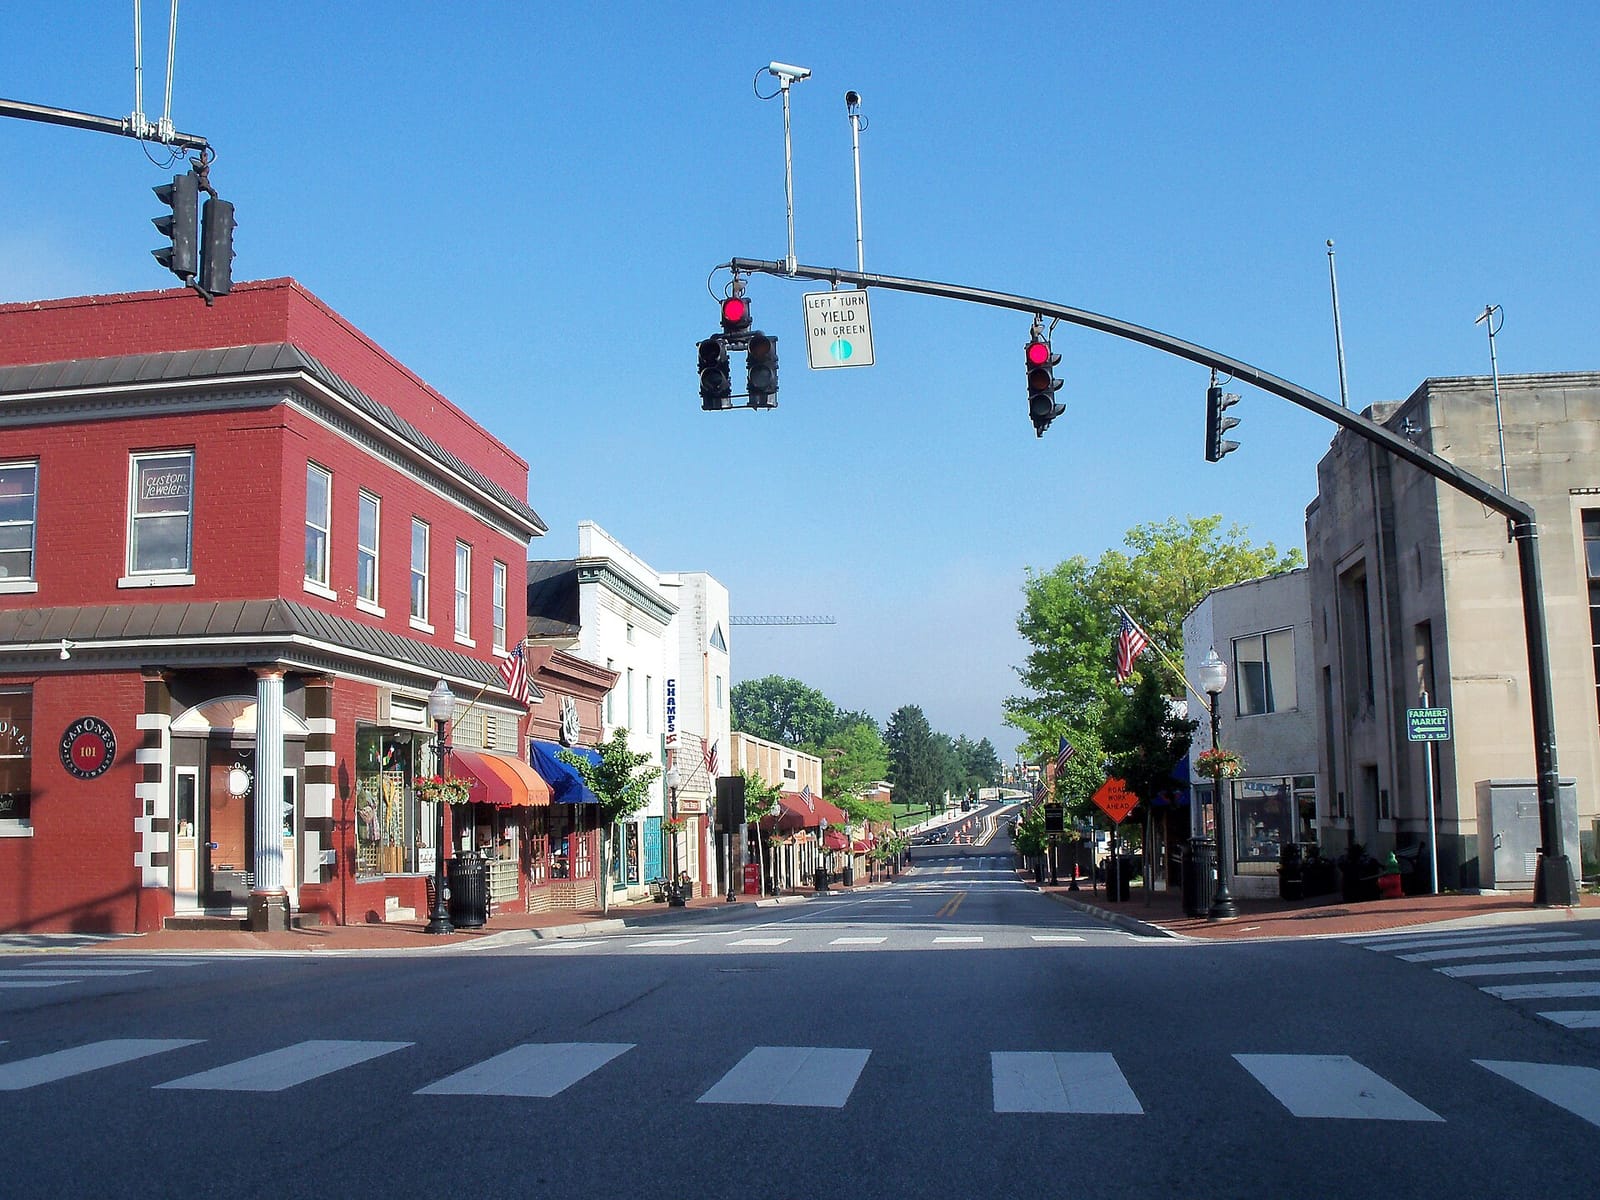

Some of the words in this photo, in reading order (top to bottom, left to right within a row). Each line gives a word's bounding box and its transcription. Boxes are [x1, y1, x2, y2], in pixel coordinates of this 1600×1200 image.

[808, 298, 831, 309] LEFT
[839, 296, 865, 307] TURN
[821, 310, 855, 323] YIELD
[813, 327, 827, 337] ON
[832, 324, 865, 336] GREEN
[146, 472, 187, 486] custom
[666, 678, 676, 733] CHAMPS
[1409, 709, 1448, 718] FARMERS
[1411, 717, 1447, 726] MARKET
[80, 746, 96, 757] 101
